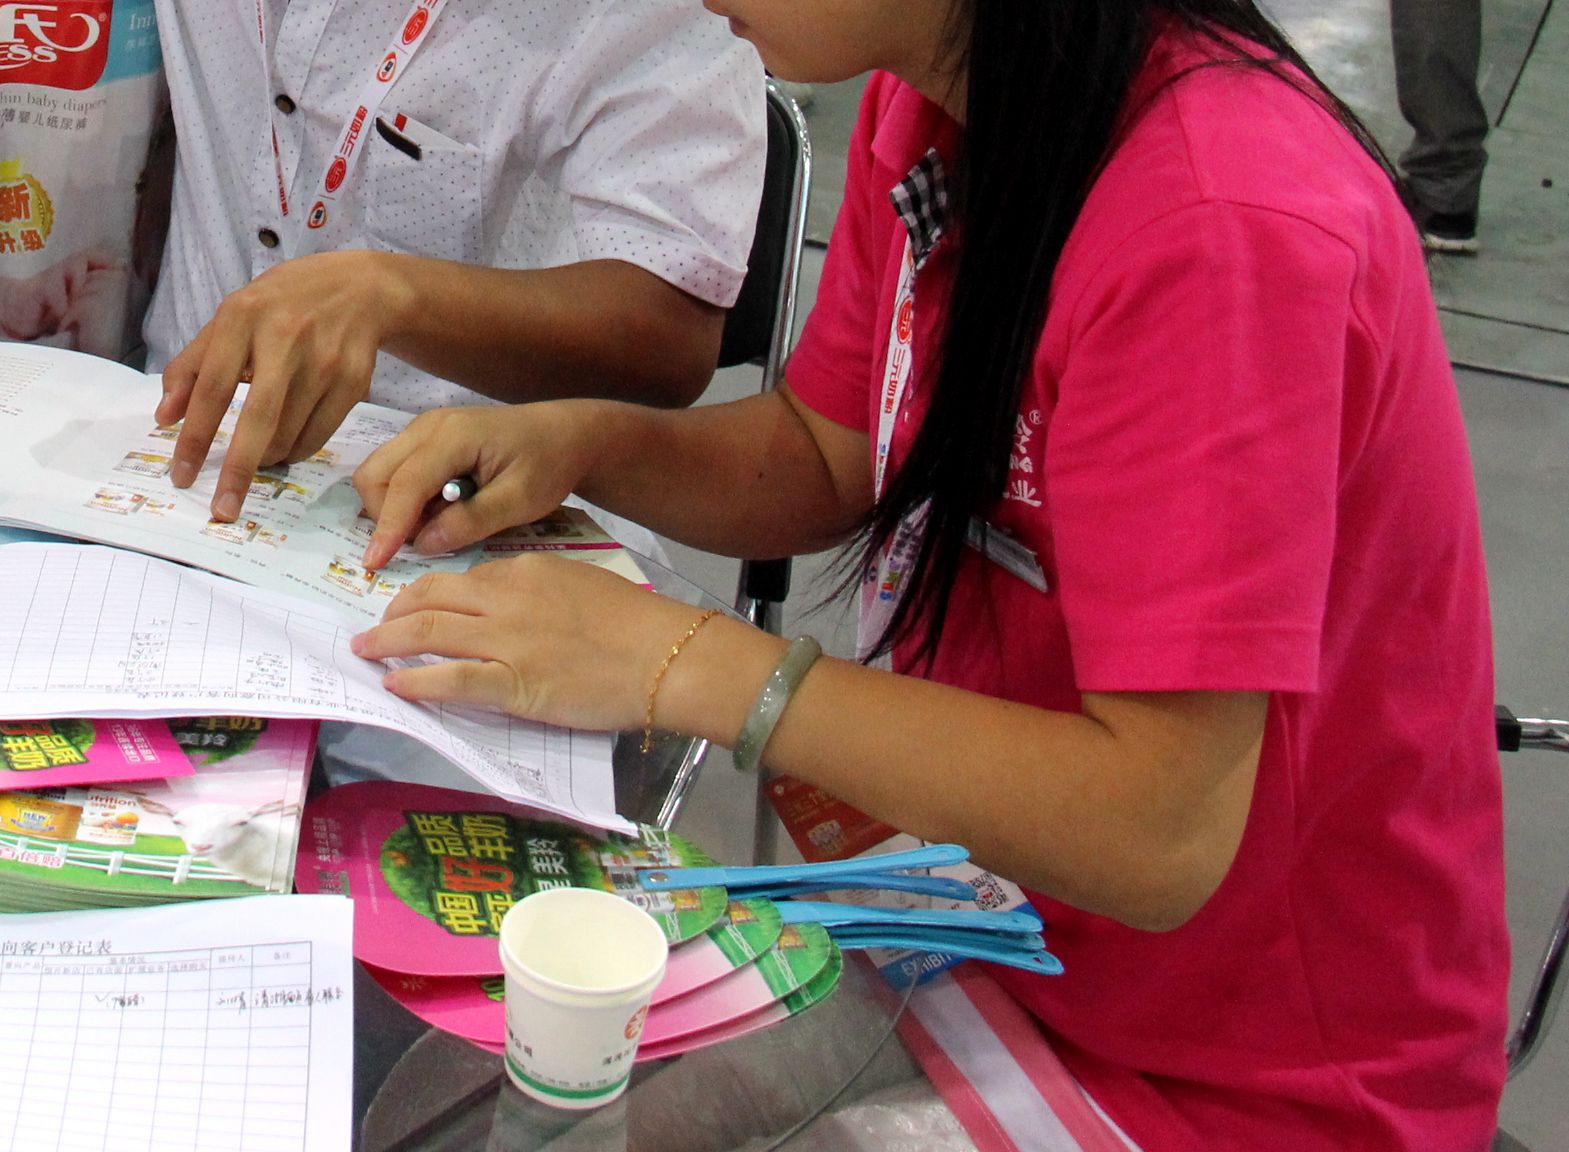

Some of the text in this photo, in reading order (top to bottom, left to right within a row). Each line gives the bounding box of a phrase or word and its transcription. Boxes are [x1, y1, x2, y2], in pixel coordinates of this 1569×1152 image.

[25, 91, 58, 113] baby
[63, 97, 108, 115] diapers
[339, 105, 368, 158] 三元奶粉
[2, 736, 48, 771] 羊奶
[34, 734, 84, 766] 品质
